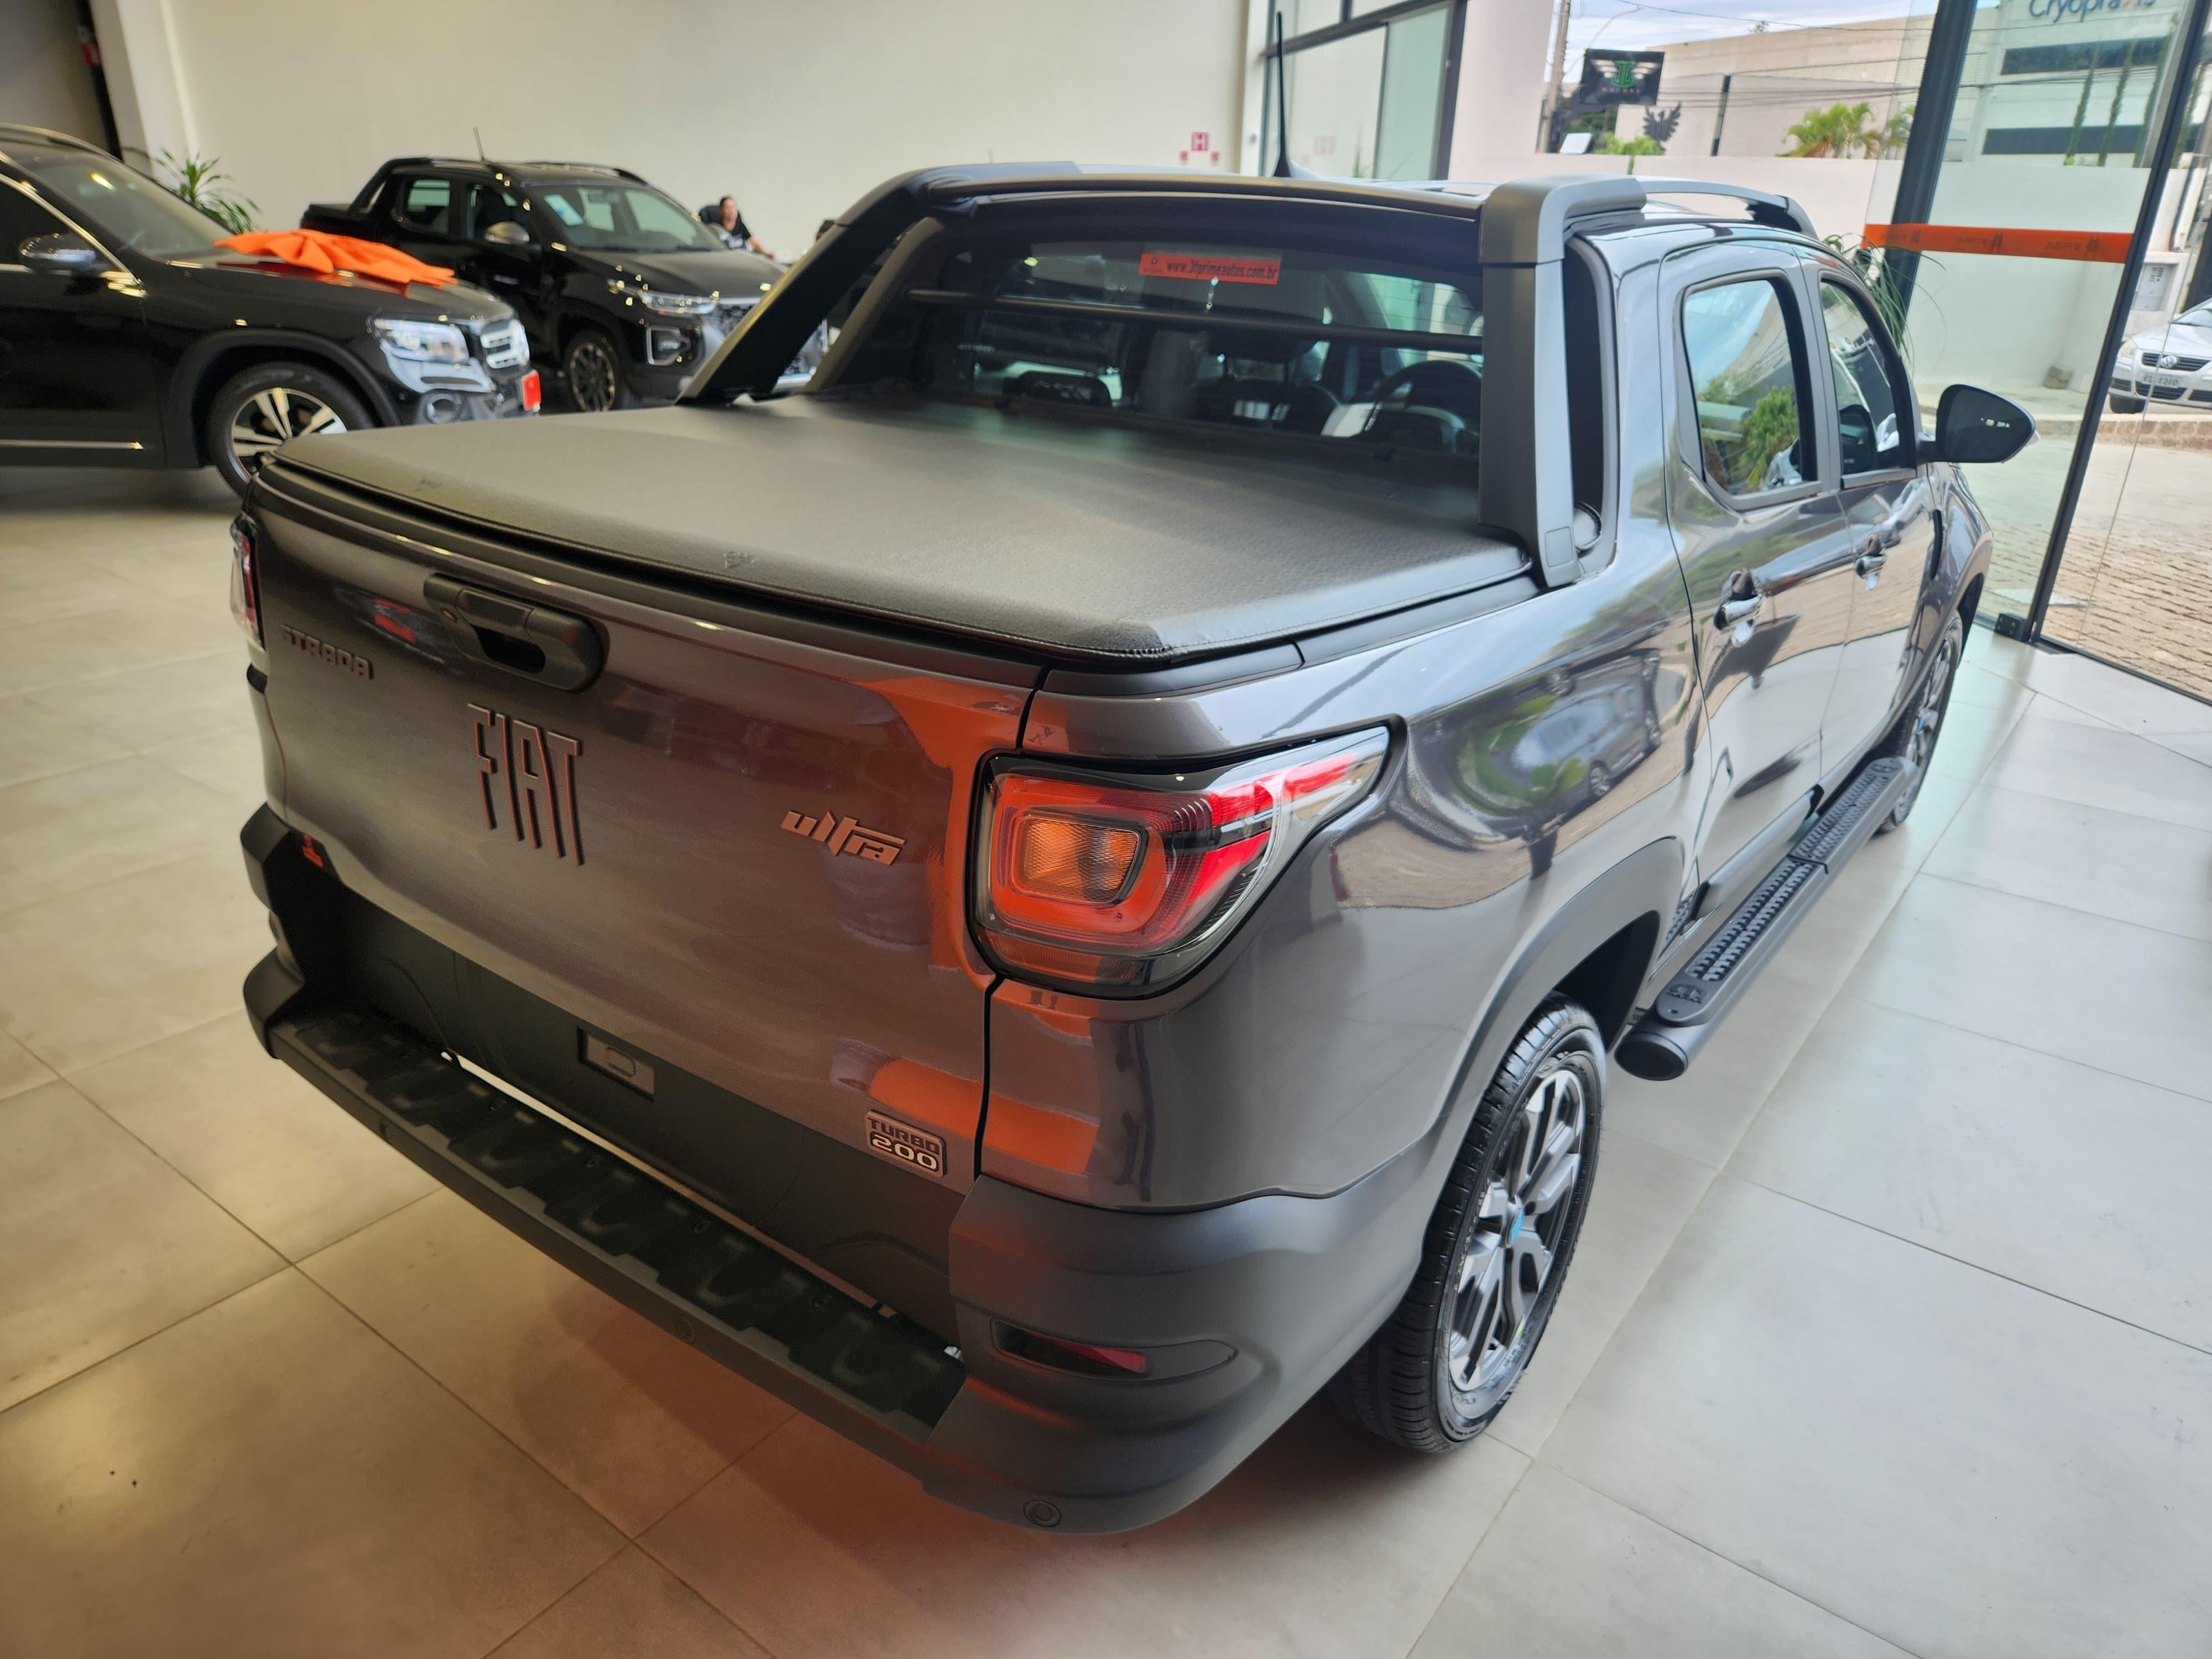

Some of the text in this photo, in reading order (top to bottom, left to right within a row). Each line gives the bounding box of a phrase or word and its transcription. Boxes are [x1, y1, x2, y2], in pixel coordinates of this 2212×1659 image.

[467, 701, 585, 867] FIAT
[867, 1117, 940, 1155] TURBO
[872, 1133, 937, 1170] 200
